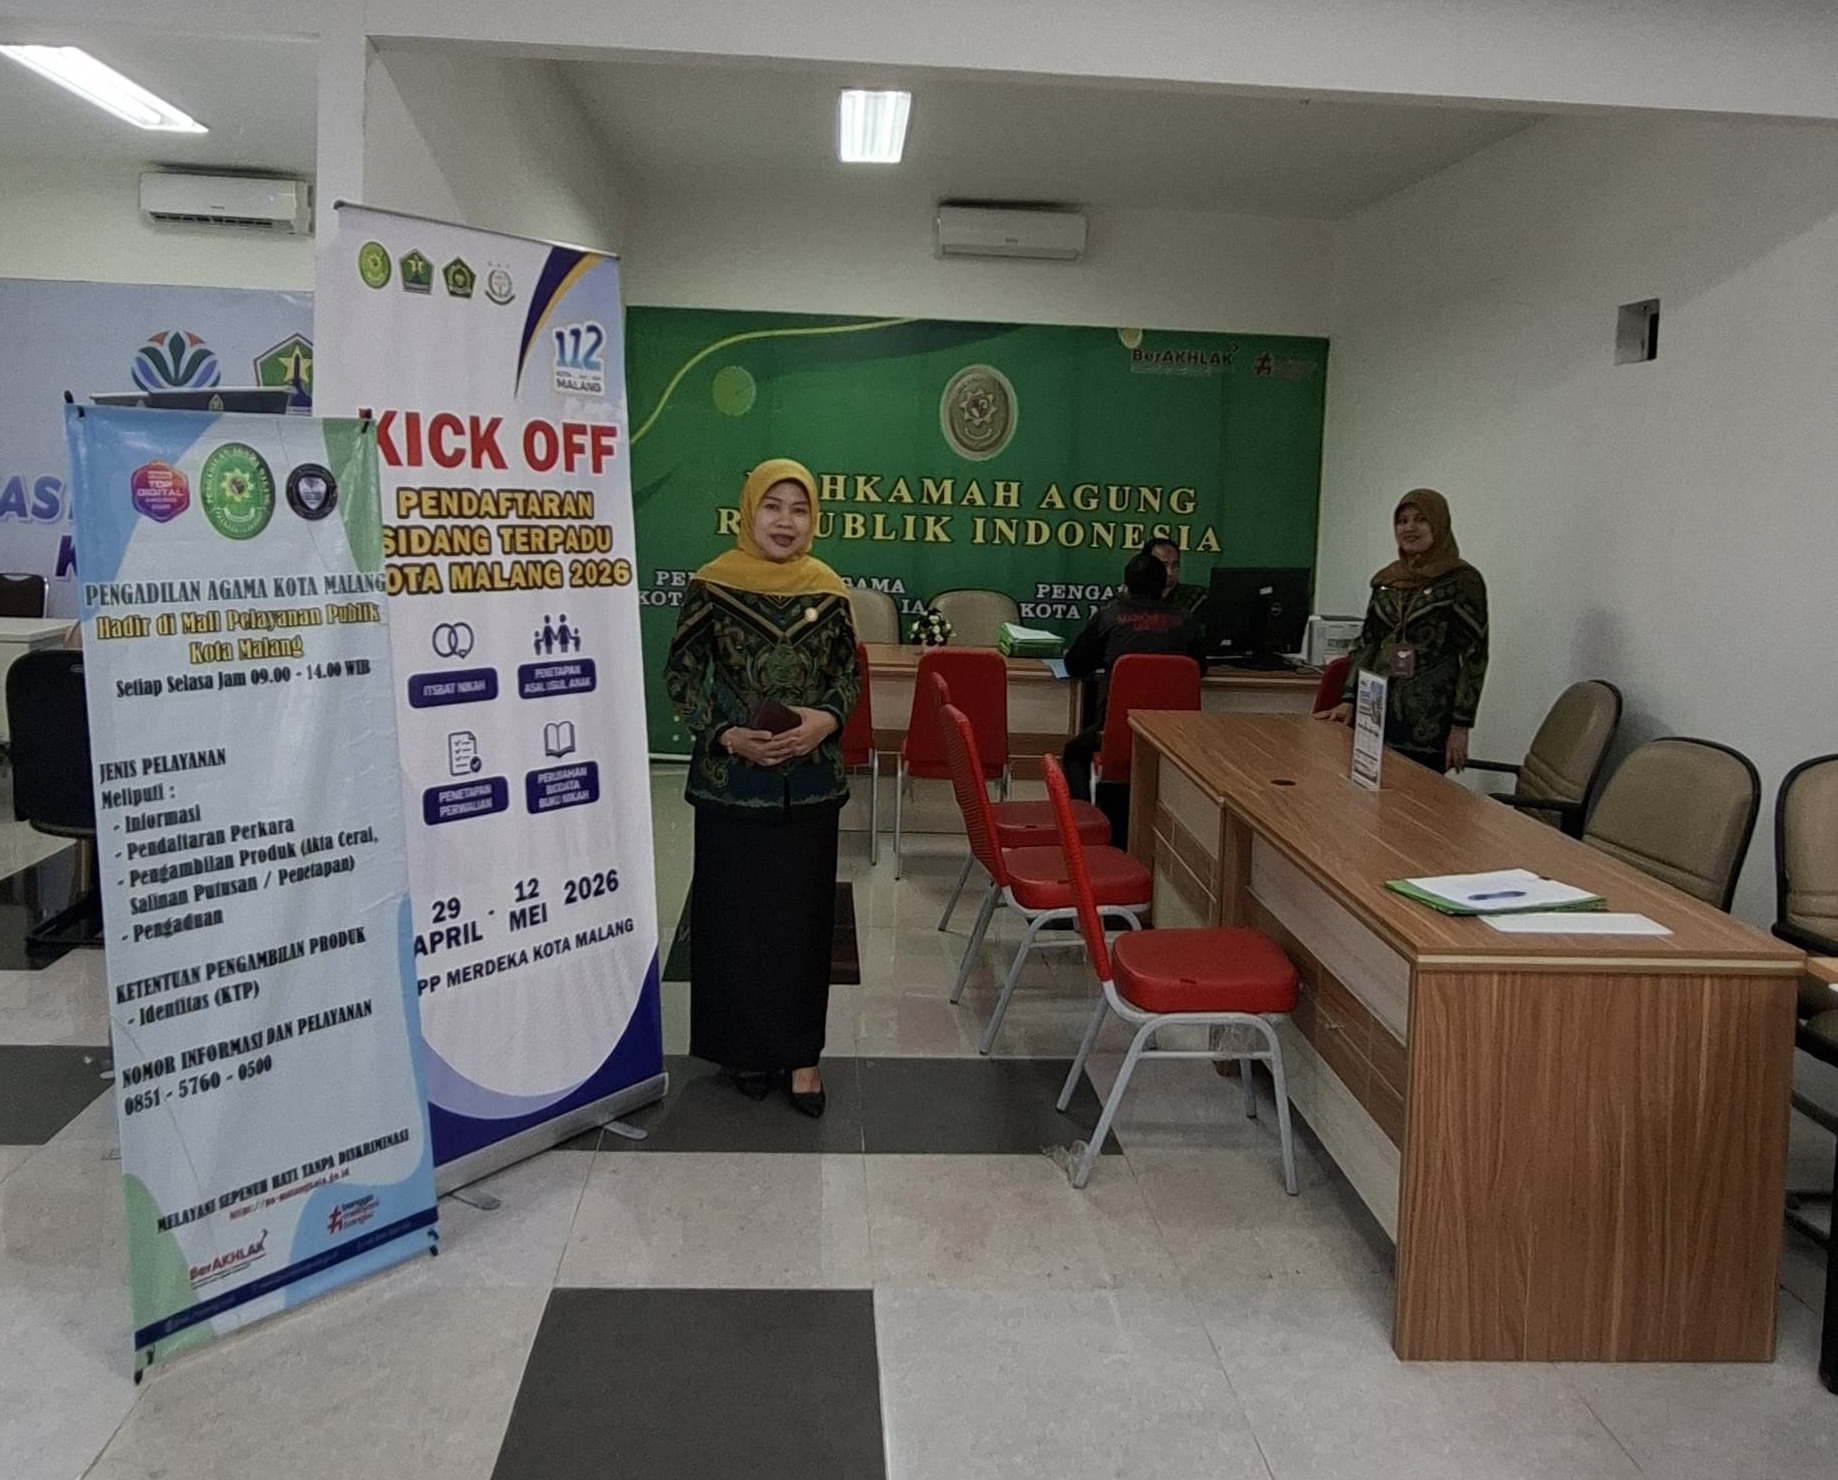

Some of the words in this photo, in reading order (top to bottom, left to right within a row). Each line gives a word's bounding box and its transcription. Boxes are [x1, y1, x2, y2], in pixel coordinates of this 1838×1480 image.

[555, 325, 603, 371] 112
[360, 408, 508, 470] KICK
[523, 420, 617, 474] OFF
[396, 487, 595, 520] PENDAFTARAN
[818, 473, 1021, 508] HKAMAH
[1039, 483, 1198, 514] AGUNG
[383, 524, 492, 558] SIDANG
[498, 525, 614, 555] TERPADU
[717, 507, 953, 542] RUBLIK
[972, 517, 1222, 552] INDONESIA
[85, 580, 201, 606] PENGADILAN
[207, 577, 268, 601] AGAMA
[273, 576, 319, 598] KOTA
[324, 574, 386, 595] MALANG
[385, 562, 443, 596] OTA
[449, 560, 564, 592] MALANG
[569, 558, 632, 588] 2026
[844, 578, 905, 594] GAMA
[96, 615, 151, 640] Hadir
[156, 612, 177, 636] di
[181, 610, 221, 634] Mall
[225, 608, 322, 632] Pelayanan
[325, 602, 380, 625] Publik
[1020, 603, 1081, 620] KOTA
[189, 641, 234, 665] Kota
[237, 635, 303, 660] Malang
[116, 678, 163, 698] Setiap
[166, 674, 214, 693] Selasa
[217, 671, 246, 691] Jam
[250, 667, 291, 685] 09.00
[306, 662, 341, 680] 14.00
[344, 659, 371, 675] WIB
[99, 760, 137, 784] JENIS
[141, 748, 226, 776] PELAYANAN
[101, 782, 165, 810] Meliputi
[125, 803, 202, 834] Informasi
[127, 829, 226, 861] Pendaftaran
[230, 818, 295, 842] Perkara
[129, 854, 235, 888] Pengambilan
[239, 842, 297, 867] Produk
[300, 835, 334, 858] (Akta
[130, 889, 189, 916] Salinan
[193, 876, 258, 902] Putusan
[278, 854, 355, 886] Penetapan)
[514, 877, 540, 903] 12
[563, 868, 619, 905] 2026
[133, 909, 224, 943] Pengaduan
[432, 896, 461, 924] 29
[509, 902, 548, 932] MEI
[413, 920, 483, 958] APRIL
[446, 952, 529, 988] MERDEKA
[533, 940, 571, 962] KOTA
[575, 917, 635, 949] MALANG
[115, 966, 201, 1005] KETENTUAN
[205, 939, 305, 982] PENGAMBILAN
[309, 926, 367, 956] PRODUK
[139, 993, 210, 1027] Identitas
[214, 980, 260, 1007] (KTP)
[122, 1055, 176, 1089] NOMOR
[180, 1031, 263, 1069] INFORMASI
[266, 1021, 293, 1046] DAN
[297, 999, 373, 1036] PELAYANAN
[124, 1087, 161, 1116] 0851
[178, 1071, 221, 1098] 5760
[238, 1053, 272, 1081] 0500
[156, 1199, 216, 1234] MELAYANI
[219, 1178, 268, 1210] SEPENUH
[272, 1166, 299, 1190] HATI
[302, 1155, 335, 1179] TANPA
[338, 1128, 410, 1166] DISKRIMINASI
[189, 1230, 268, 1281] BerAKHLAK
